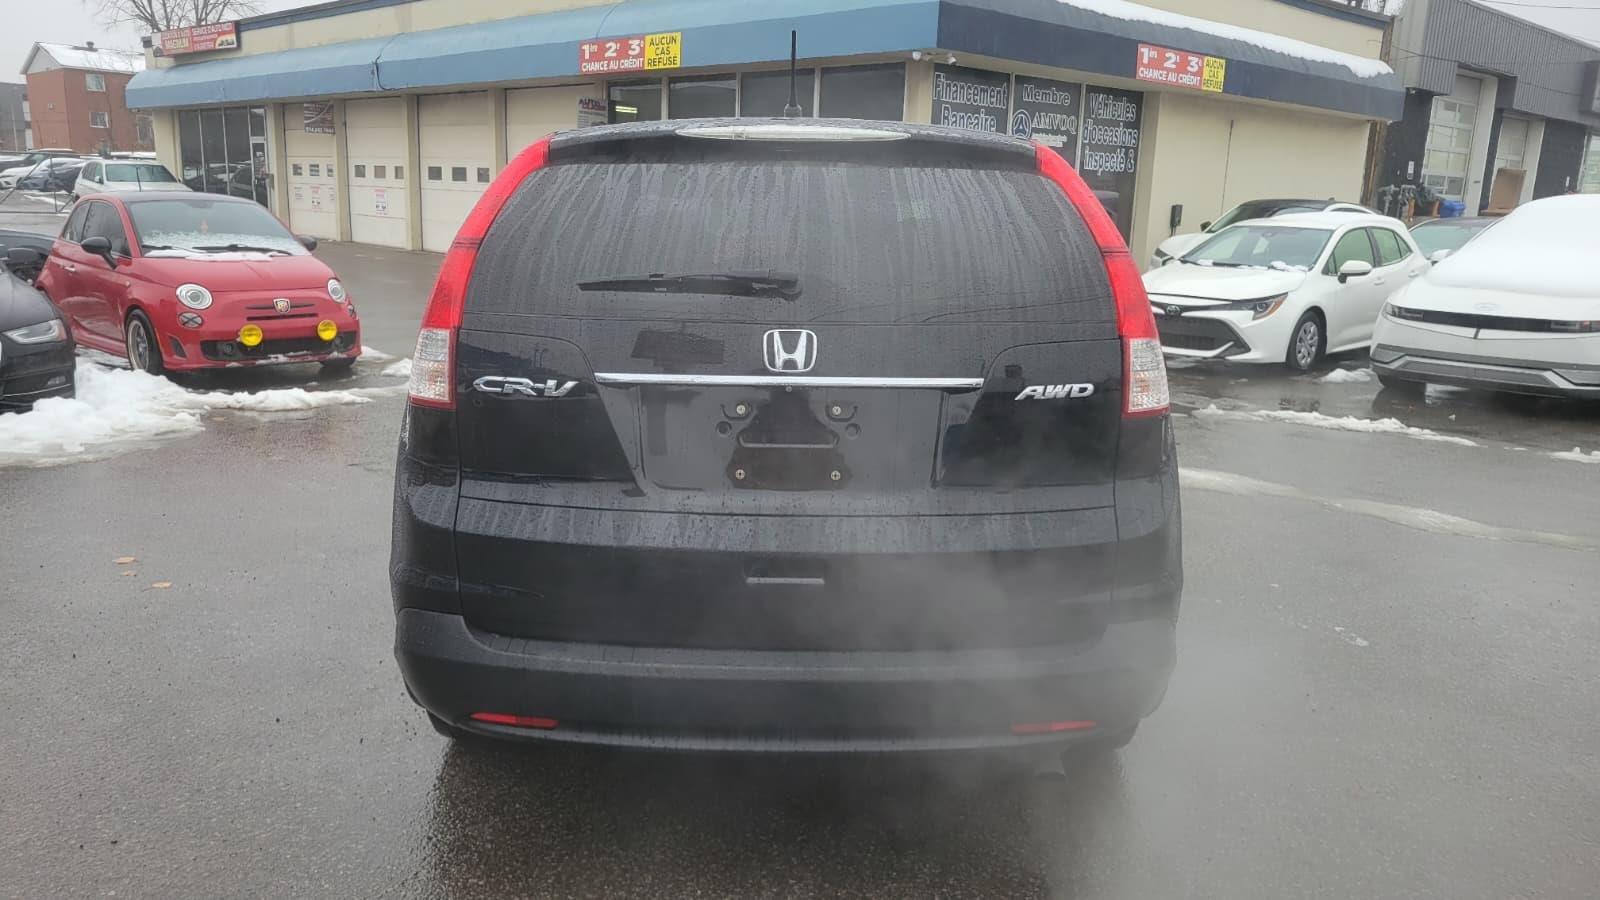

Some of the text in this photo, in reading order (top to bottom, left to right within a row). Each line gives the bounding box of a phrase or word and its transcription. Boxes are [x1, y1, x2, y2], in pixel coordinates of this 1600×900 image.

[649, 35, 677, 47] AUCUN
[654, 46, 671, 56] CAS
[581, 56, 644, 72] CHANCE AU CRÉDIT
[1138, 67, 1201, 86] CHANCE AU CRÉDIT
[933, 72, 1007, 109] Financement
[1023, 84, 1071, 106] Membre
[941, 104, 996, 133] Bancaire
[1089, 93, 1137, 122] Véhicules
[1032, 112, 1078, 135] AMVOQ
[1083, 119, 1139, 147] d'occasions
[1084, 146, 1126, 176] inspecté
[473, 376, 579, 397] CR-V
[1014, 383, 1095, 401] AWD
